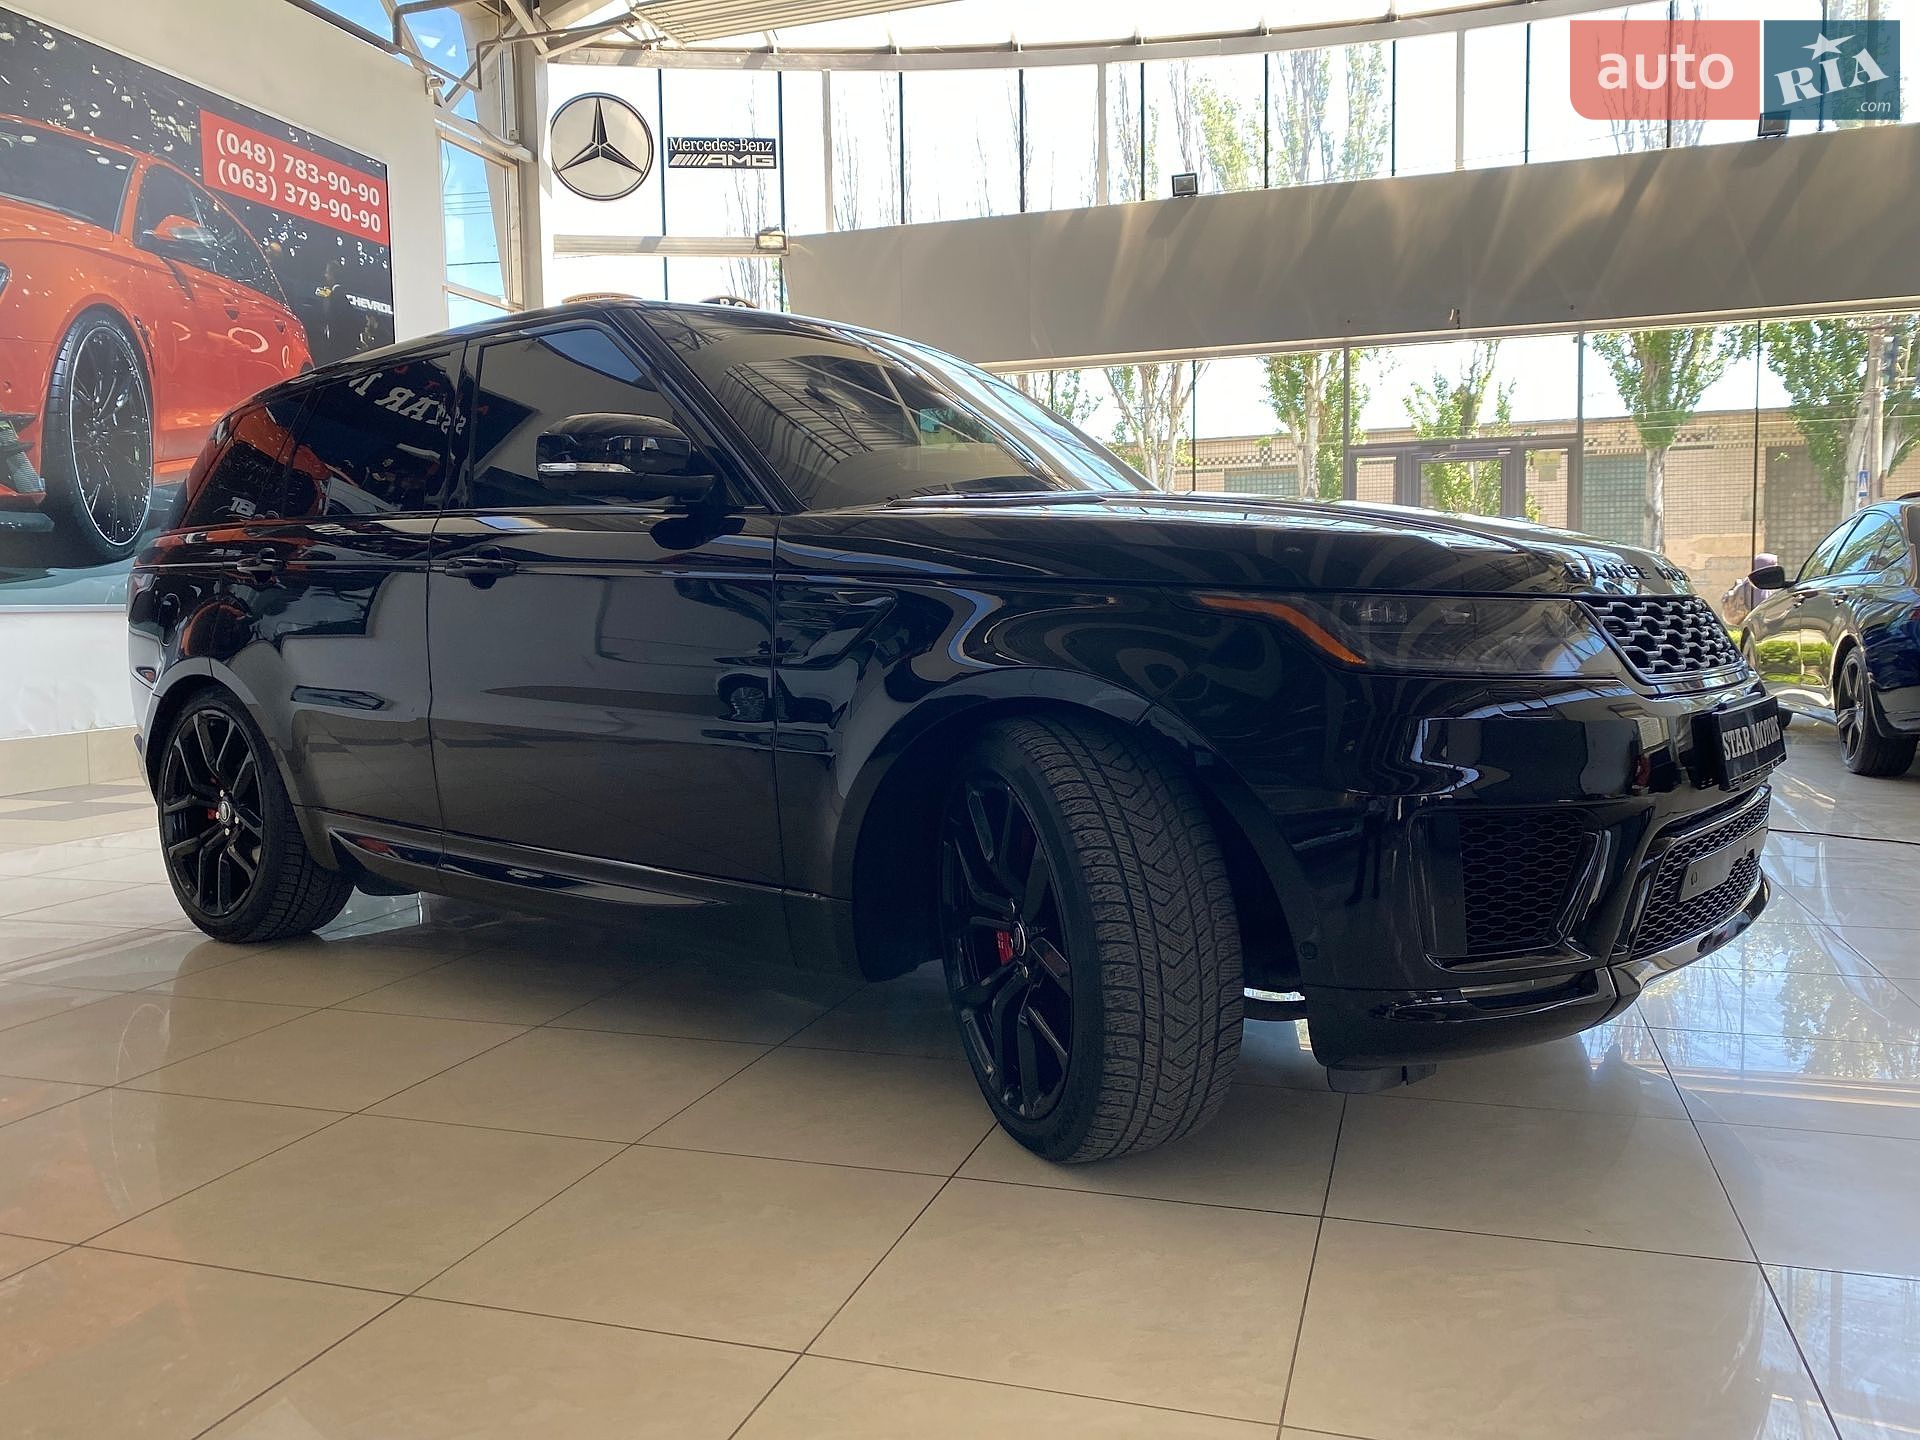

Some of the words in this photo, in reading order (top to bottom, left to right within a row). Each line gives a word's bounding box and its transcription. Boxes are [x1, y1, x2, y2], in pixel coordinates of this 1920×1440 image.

[216, 129, 276, 172] (048)
[283, 153, 380, 206] 783-90-90
[669, 138, 773, 152] Mercedes-Benz
[218, 159, 277, 201] (063)
[284, 183, 381, 232] 379-90-90
[1722, 726, 1753, 761] STAR
[1751, 715, 1781, 751] MOTORS
